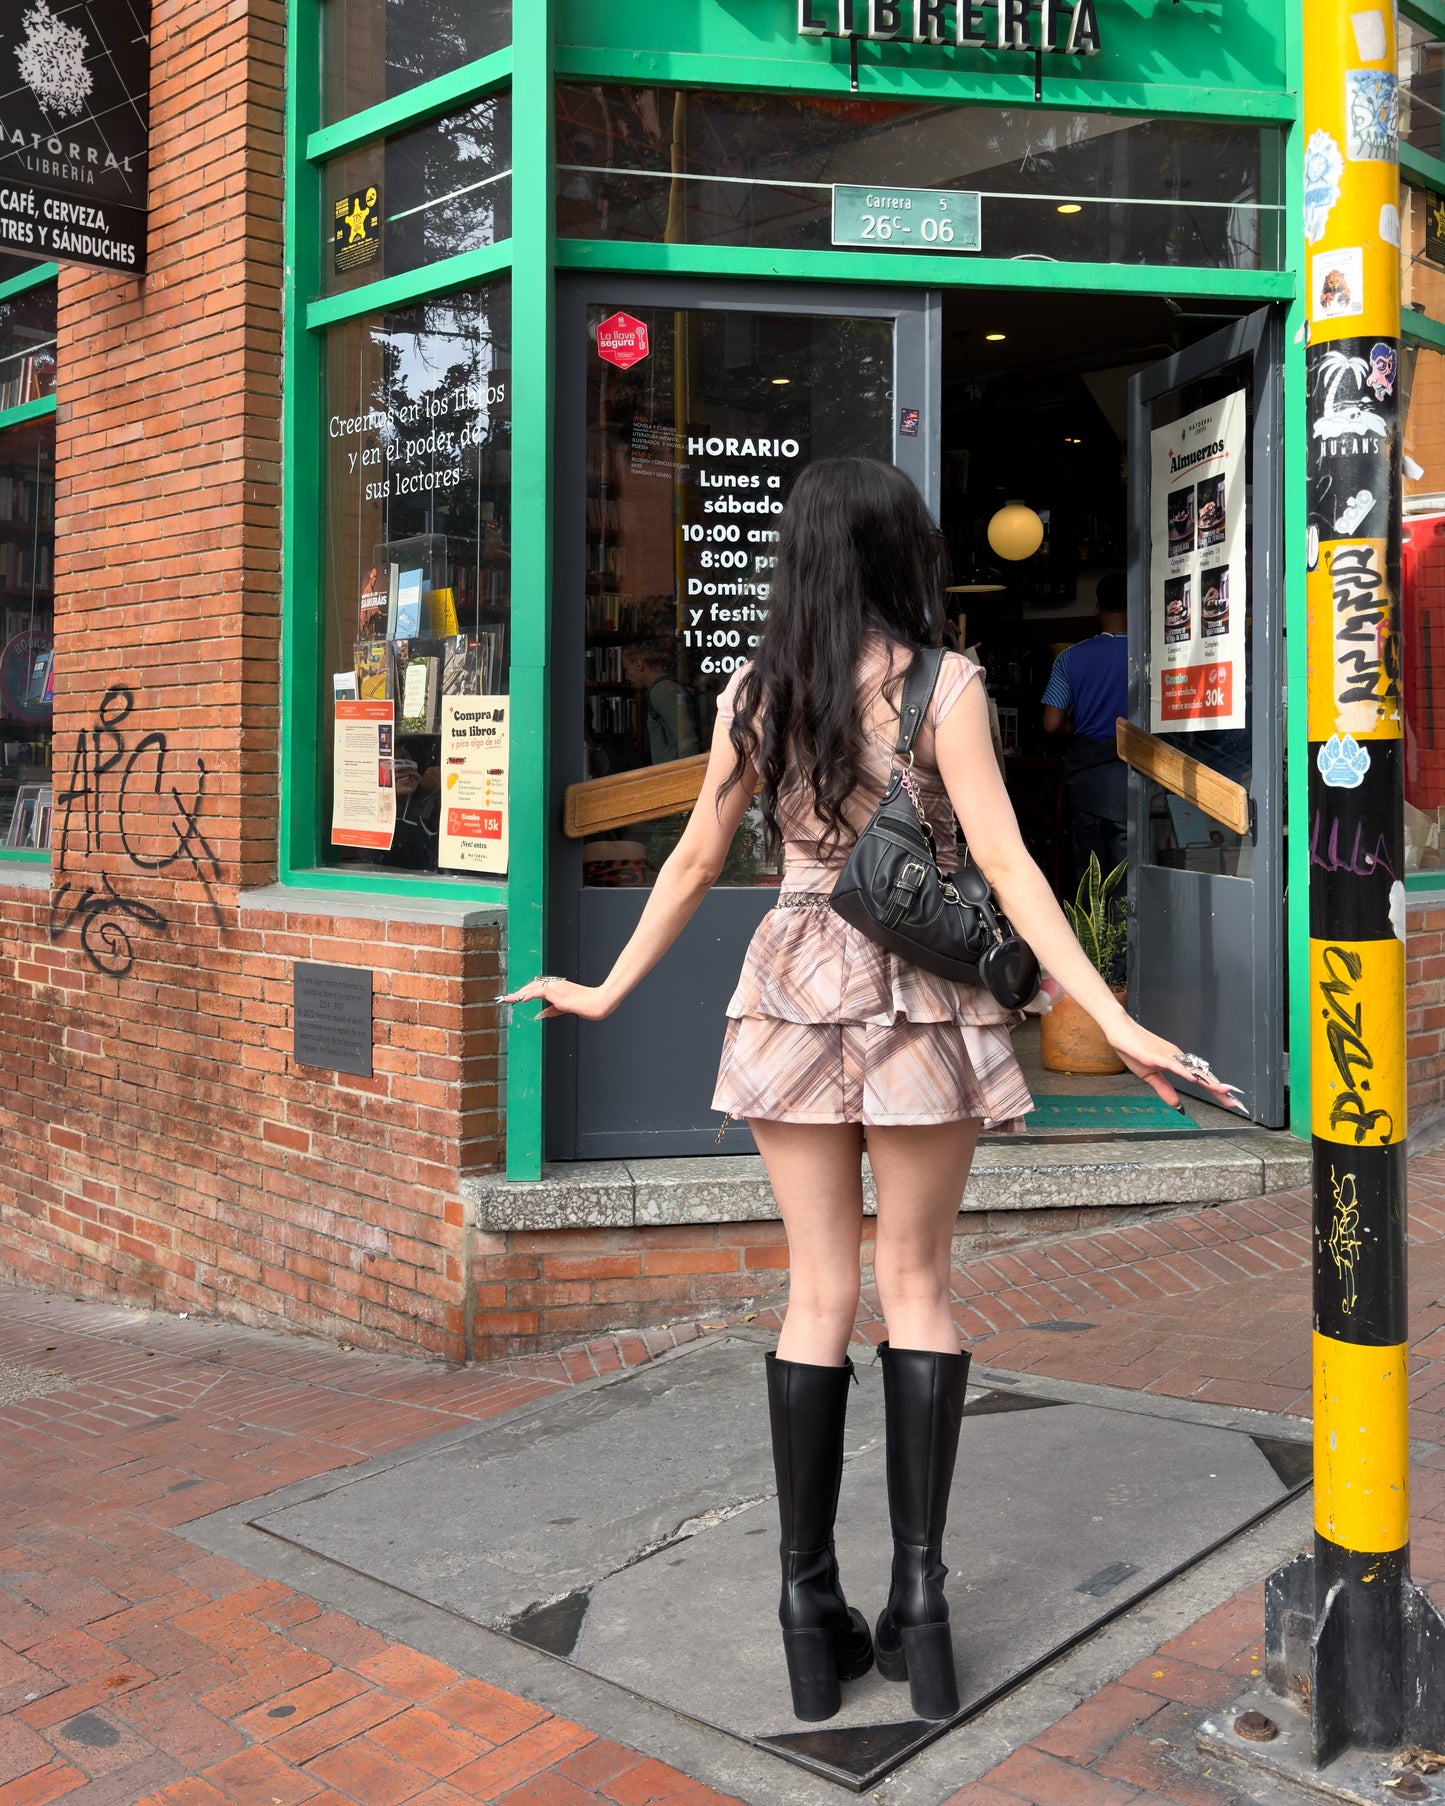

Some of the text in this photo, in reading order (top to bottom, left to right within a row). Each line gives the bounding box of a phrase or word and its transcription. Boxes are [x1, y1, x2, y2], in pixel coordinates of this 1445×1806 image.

[27, 155, 94, 184] LIBRERÍA
[1, 189, 109, 234] CAFÉ, CERVEZA,
[866, 194, 948, 211] Carrera 5
[920, 217, 954, 242] 06
[0, 218, 136, 264] TRES Y SÁNDUCHES
[600, 330, 635, 340] La llave
[600, 339, 635, 349] segura
[329, 383, 505, 438] Creemos en los libros
[348, 421, 482, 474] y en el poder de
[688, 437, 799, 457] HORARIO
[1170, 439, 1224, 474] Almuerzos
[365, 466, 461, 500] sus lectores
[700, 470, 780, 488] Lunes a
[704, 495, 784, 514] sábado
[681, 524, 740, 542] 10:00
[700, 551, 748, 568] 8:00
[688, 578, 771, 600] Doming
[690, 609, 703, 626] y
[683, 630, 740, 647] 11:00
[1205, 687, 1224, 707] 30k
[454, 710, 491, 722] Compra
[451, 725, 496, 737] tus libros
[484, 819, 499, 831] 15k
